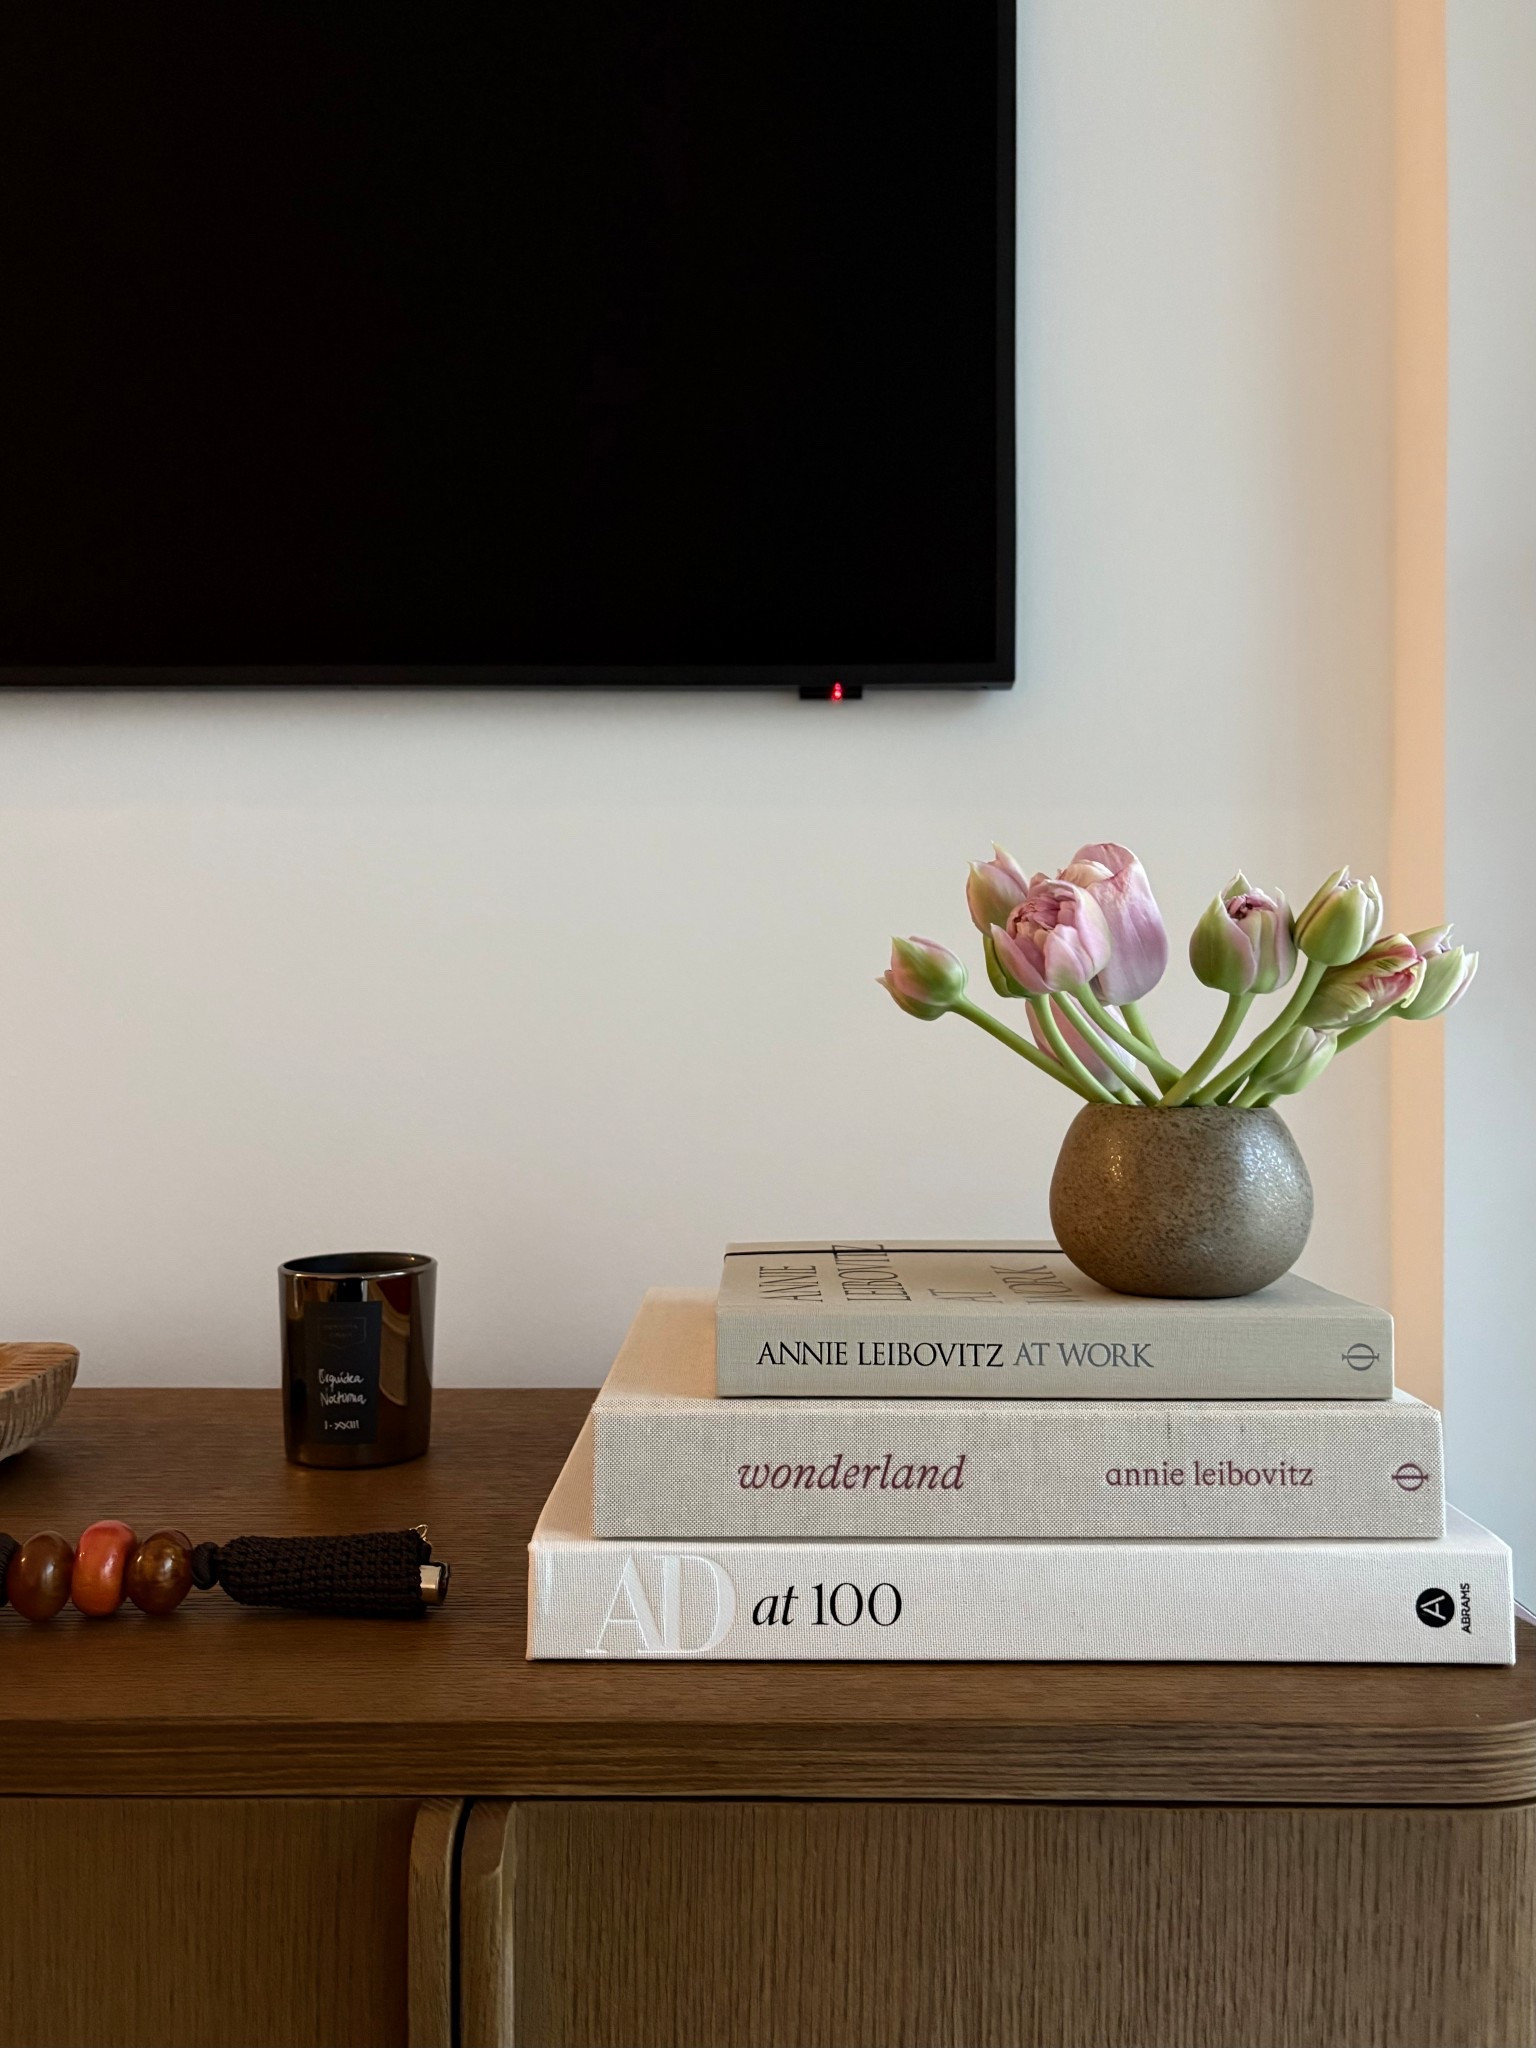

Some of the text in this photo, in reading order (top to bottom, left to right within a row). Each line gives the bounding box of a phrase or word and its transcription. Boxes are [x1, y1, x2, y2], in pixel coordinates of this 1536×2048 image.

[759, 1265, 823, 1303] ANNIE
[832, 1244, 912, 1302] LEIBOVITZ
[990, 1264, 1086, 1304] WORK
[928, 1288, 1004, 1304] AT
[755, 1341, 1155, 1368] ANNIE LEIBOVITZ AT WORK
[738, 1454, 966, 1491] wonderland
[1106, 1458, 1315, 1488] annie leibovitz
[585, 1554, 903, 1654] AD at 100
[1461, 1583, 1472, 1634] ABRAMS
